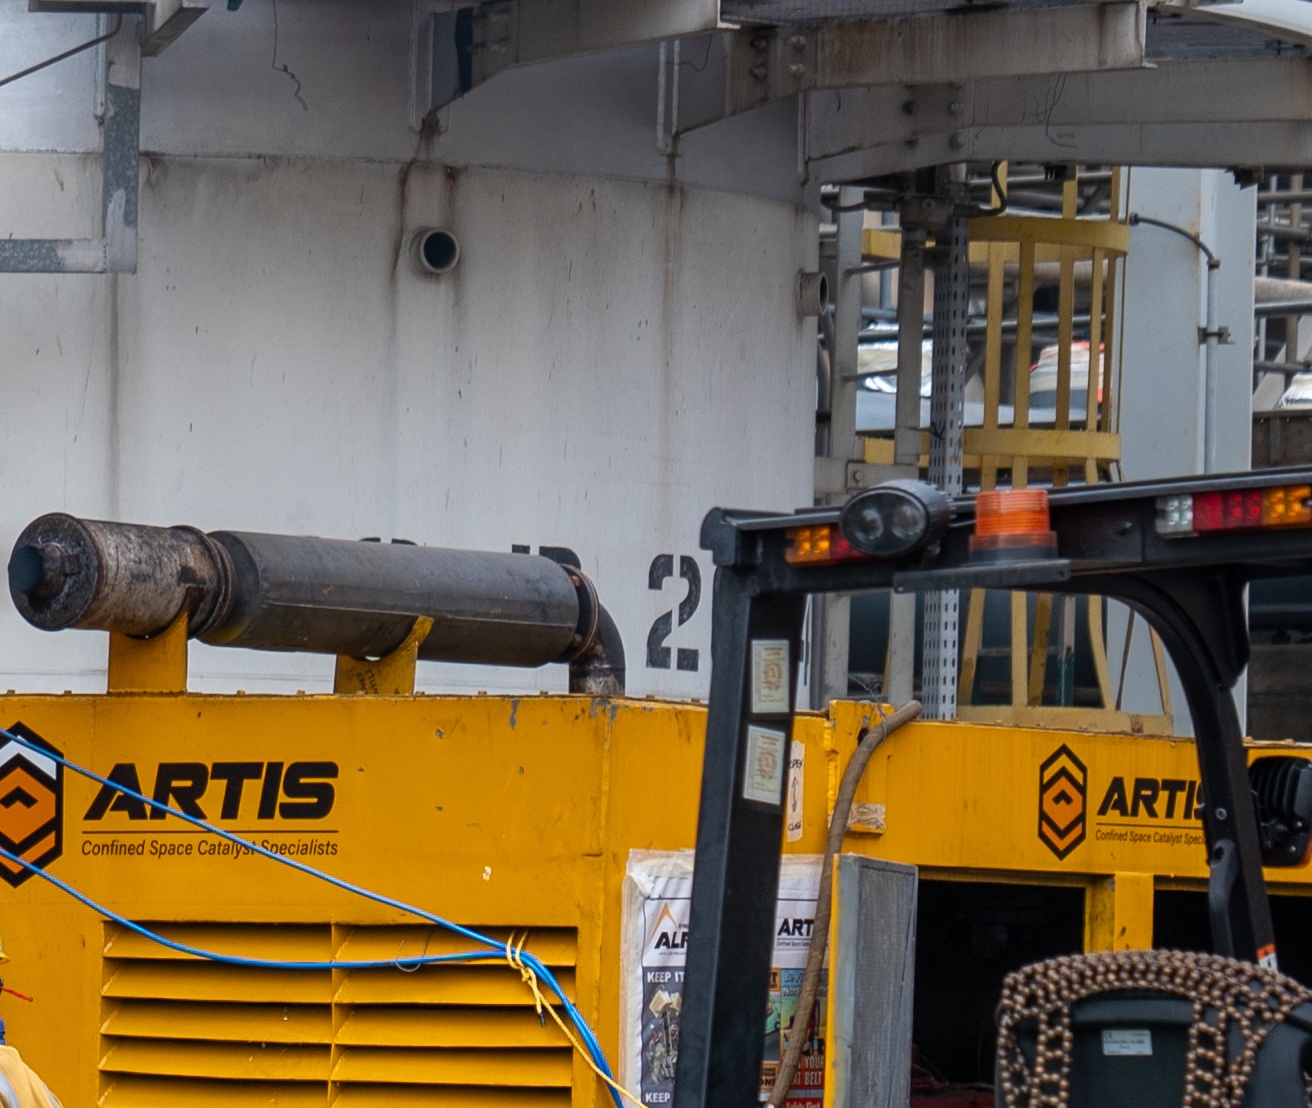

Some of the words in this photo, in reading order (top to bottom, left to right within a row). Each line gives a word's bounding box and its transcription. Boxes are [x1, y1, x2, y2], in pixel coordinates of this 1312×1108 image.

[646, 554, 702, 672] 2
[82, 761, 339, 820] ARTIS
[1096, 829, 1128, 842] Confined
[1130, 831, 1152, 844] Space
[1153, 832, 1183, 847] Catalyst
[81, 839, 145, 856] Confined
[149, 839, 193, 859] Space
[197, 839, 257, 860] Catalyst
[260, 839, 339, 858] Specialists
[777, 918, 816, 937] ART
[654, 931, 688, 949] ALP
[647, 971, 672, 983] KEEP
[804, 1056, 825, 1069] YOUR
[804, 1071, 823, 1086] BELT
[645, 1092, 671, 1103] KEEP
